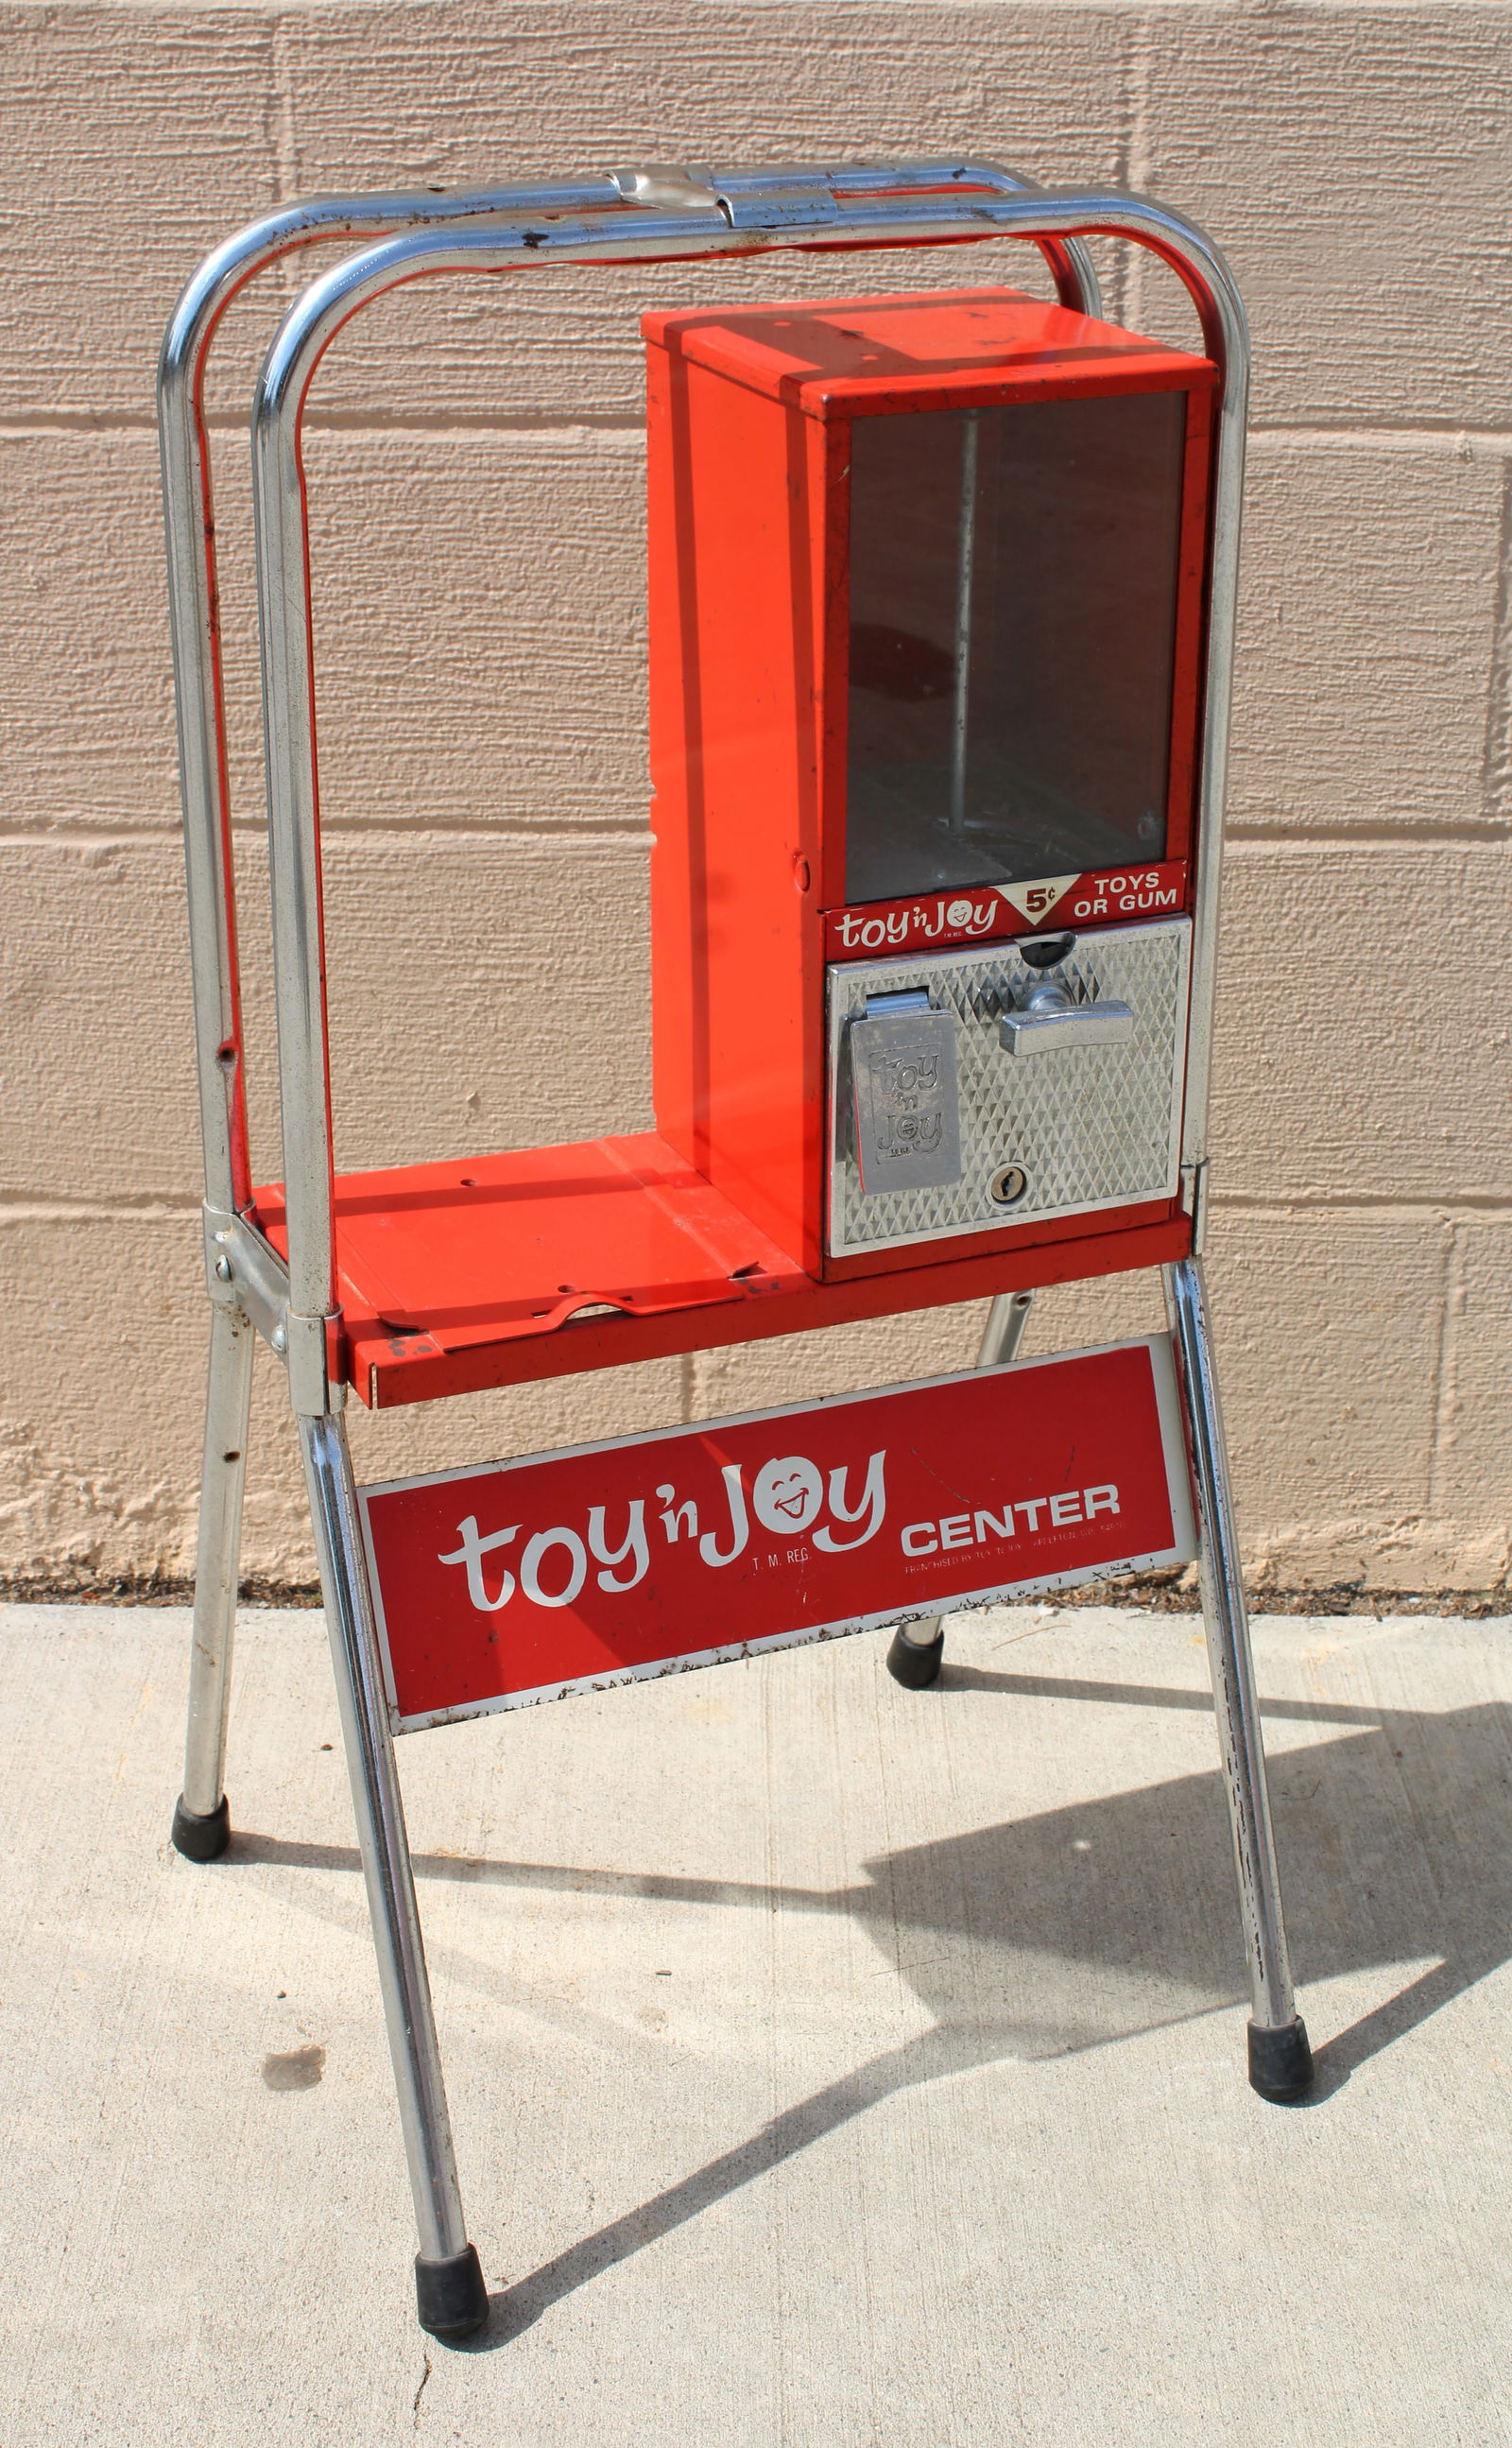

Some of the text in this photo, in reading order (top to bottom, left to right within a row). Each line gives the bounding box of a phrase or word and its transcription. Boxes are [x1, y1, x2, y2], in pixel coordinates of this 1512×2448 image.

[1094, 871, 1160, 895] TOYS
[1026, 886, 1056, 913] 5¢
[1074, 888, 1177, 918] OR GUM
[901, 1483, 1121, 1558] CENTER
